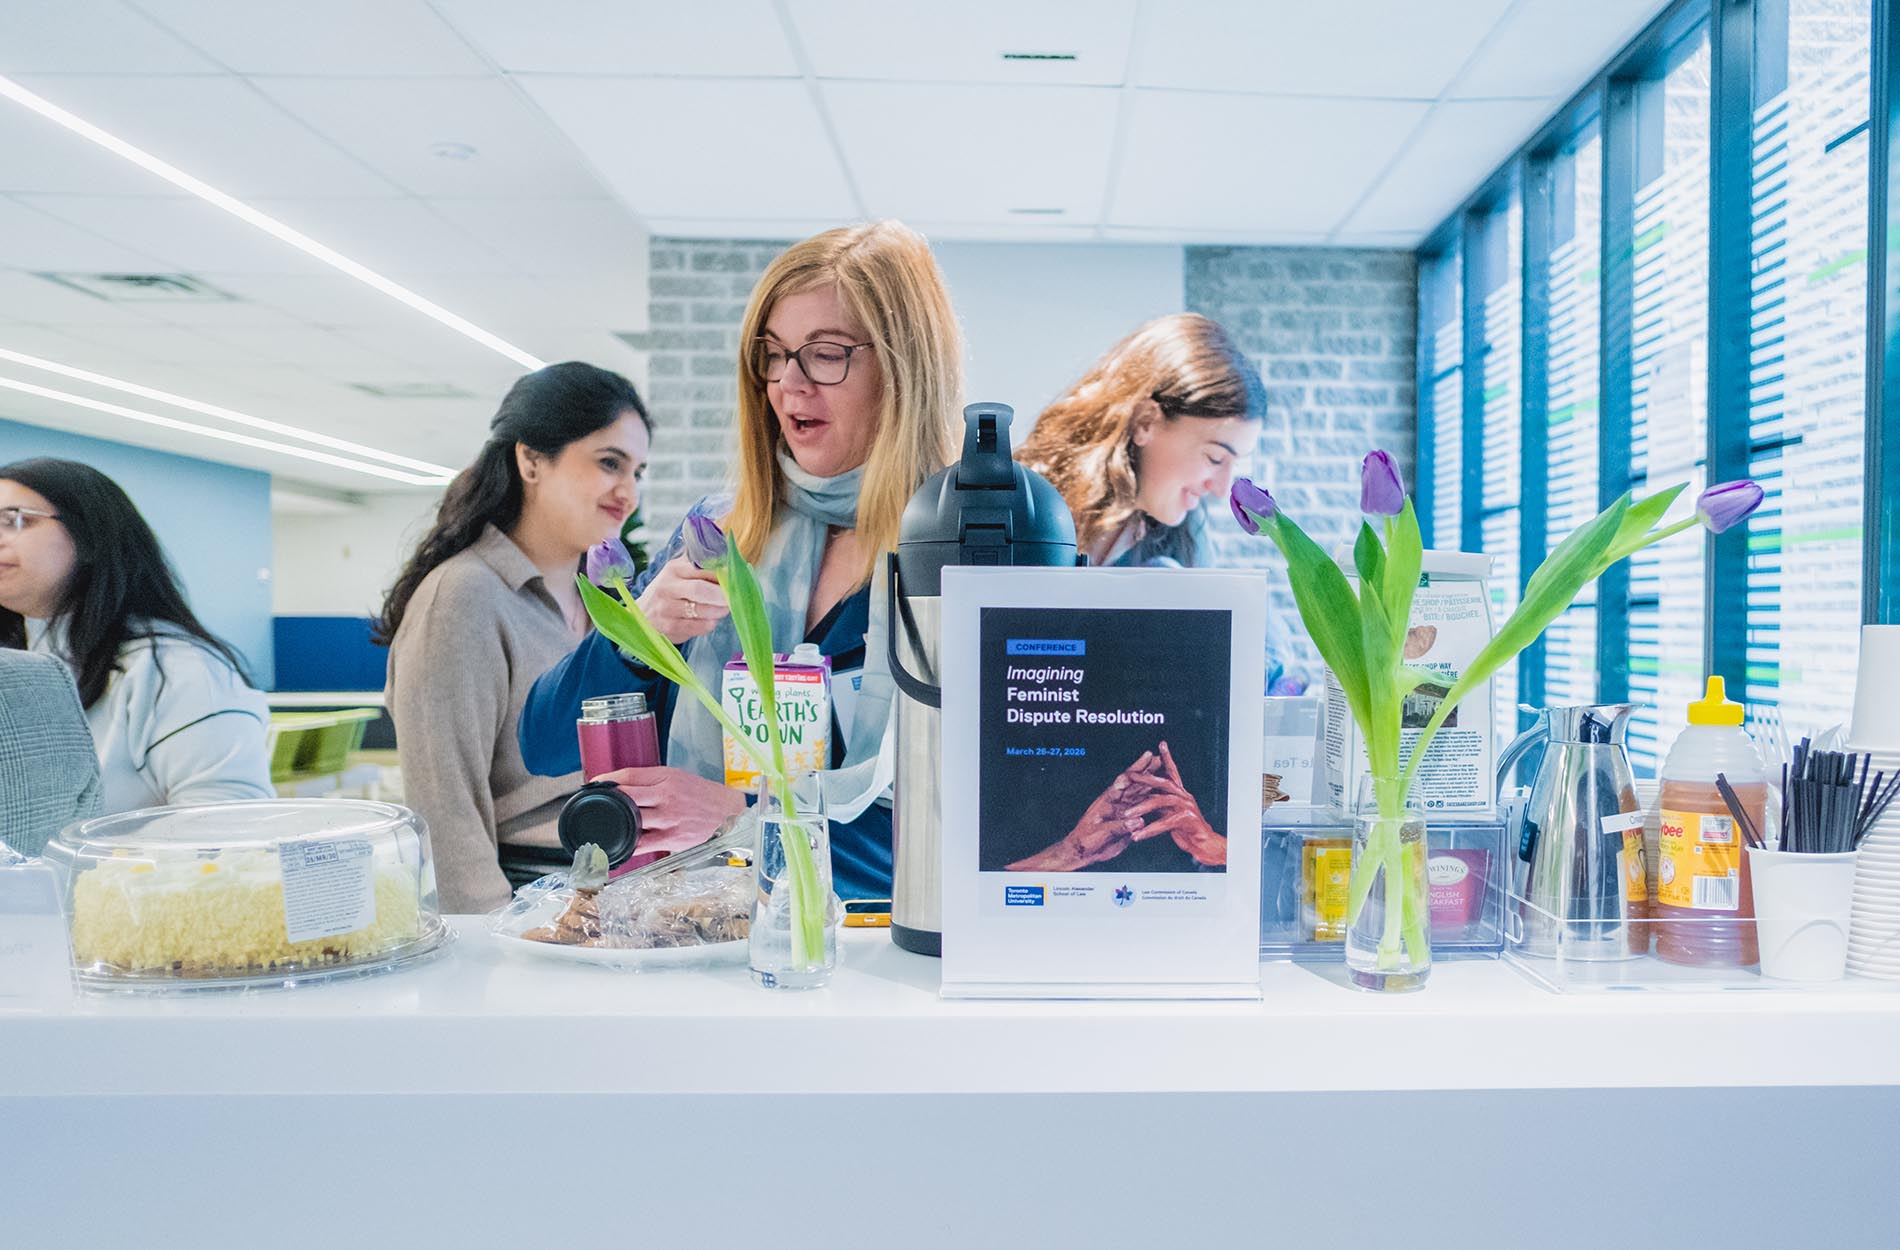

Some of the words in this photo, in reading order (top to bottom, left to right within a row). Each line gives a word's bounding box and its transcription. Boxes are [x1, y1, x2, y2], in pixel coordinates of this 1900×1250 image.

[1015, 643, 1077, 652] CONFERENCE
[1007, 665, 1084, 684] Imagining
[1007, 687, 1080, 702] Feminist
[1007, 708, 1071, 726] Dispute
[1076, 709, 1165, 724] Resolution
[1006, 747, 1034, 755] March
[1036, 747, 1063, 757] 26-27,
[1063, 748, 1086, 756] 2026
[1429, 864, 1465, 873] WININGS
